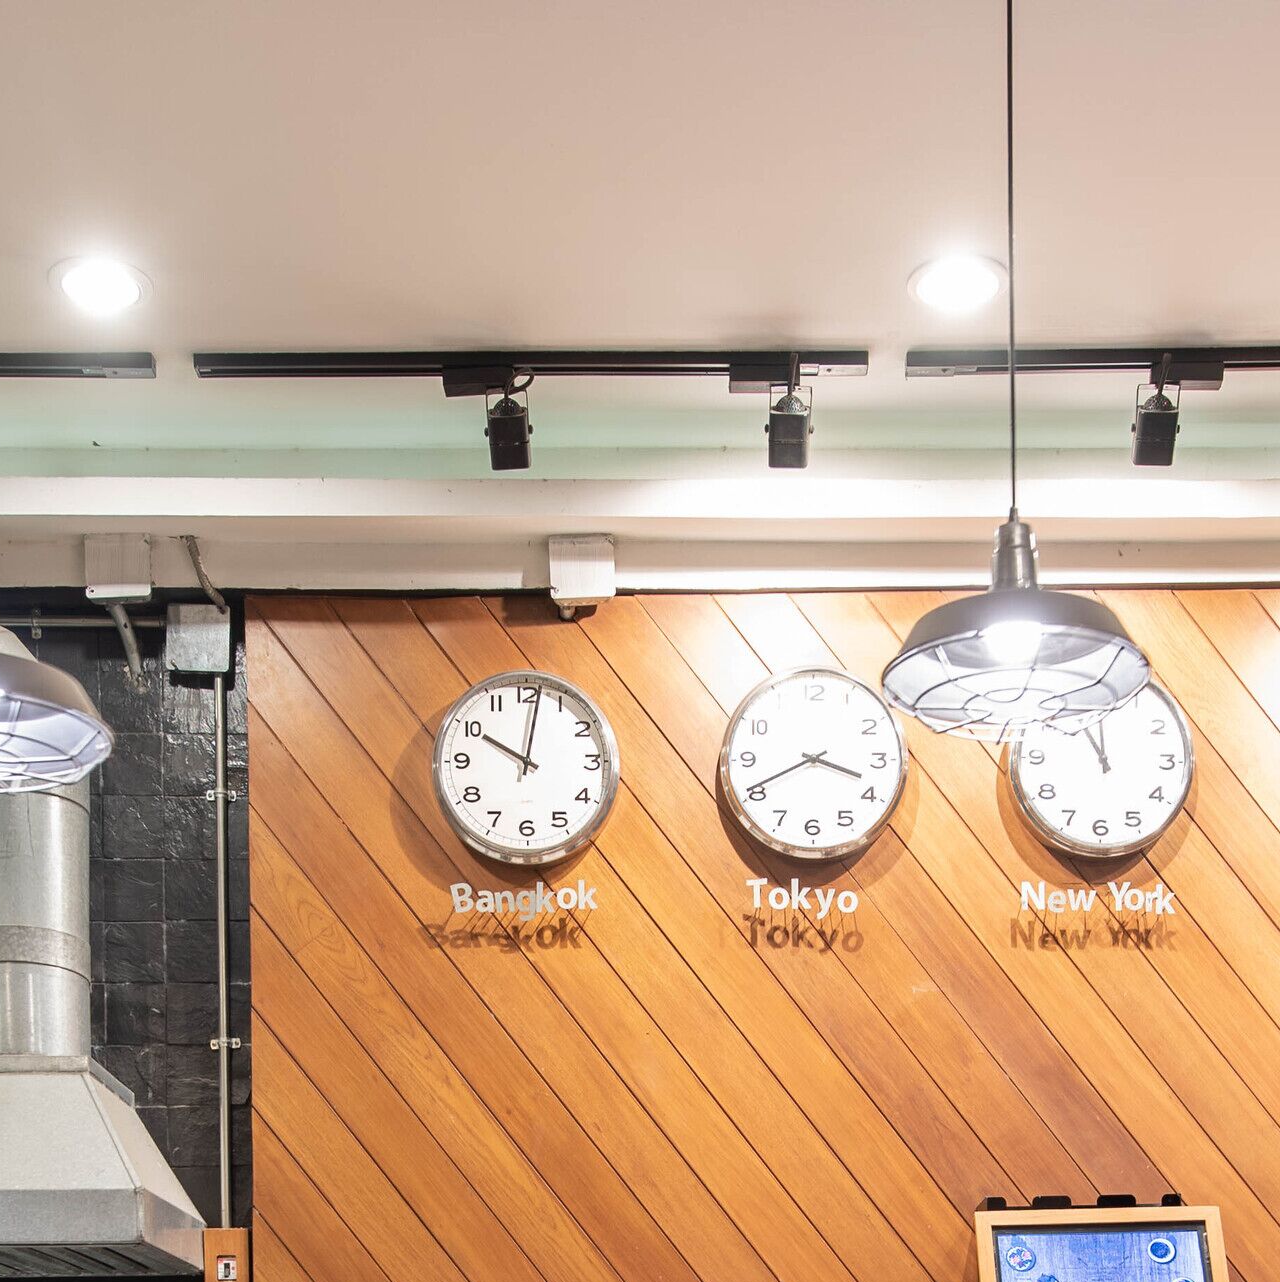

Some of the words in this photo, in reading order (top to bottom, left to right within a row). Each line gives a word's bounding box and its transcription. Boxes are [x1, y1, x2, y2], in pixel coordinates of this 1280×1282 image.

[490, 695, 502, 712] 11
[516, 687, 538, 703] 12
[558, 696, 562, 712] 1
[465, 721, 482, 737] 10
[574, 721, 591, 737] 2
[752, 719, 768, 736] 10
[861, 719, 877, 735] 2
[1150, 720, 1166, 735] 2
[454, 753, 470, 769] 9
[584, 754, 601, 771] 3
[740, 751, 756, 768] 9
[870, 752, 887, 769] 3
[1028, 749, 1045, 765] 9
[1159, 754, 1176, 771] 3
[463, 786, 481, 803] 8
[574, 788, 591, 804] 4
[748, 785, 767, 801] 8
[860, 786, 877, 803] 4
[1038, 784, 1056, 800] 8
[1148, 786, 1165, 803] 4
[487, 811, 502, 828] 7
[551, 812, 568, 828] 5
[772, 810, 788, 827] 7
[837, 810, 854, 827] 5
[1062, 810, 1076, 826] 7
[1125, 812, 1142, 828] 5
[519, 820, 535, 837] 6
[804, 819, 821, 836] 6
[1092, 820, 1109, 837] 6
[449, 879, 598, 921] Bangkok
[745, 877, 858, 920] Tokyo
[1020, 880, 1097, 913] New
[1106, 881, 1176, 914] York
